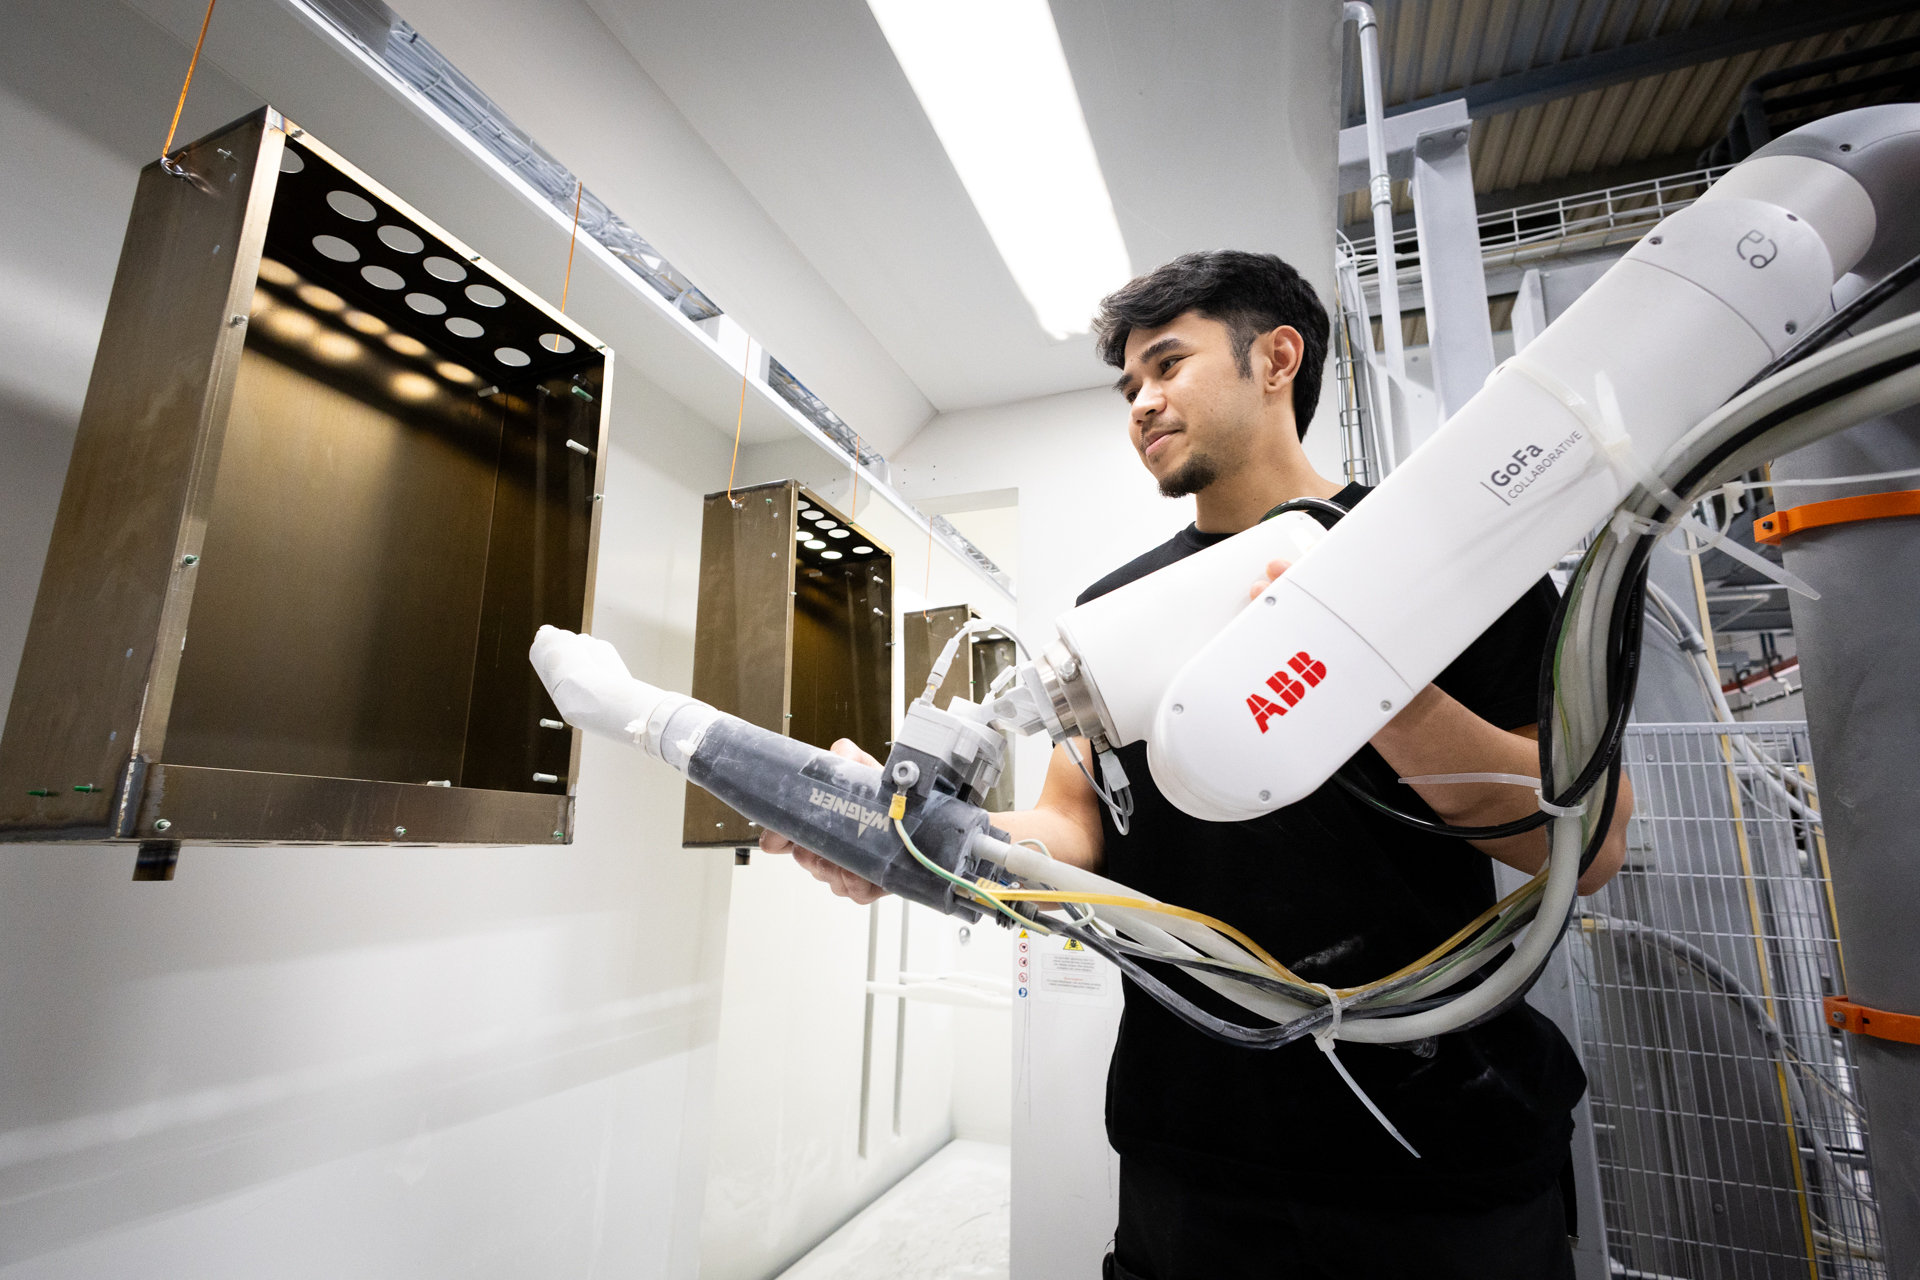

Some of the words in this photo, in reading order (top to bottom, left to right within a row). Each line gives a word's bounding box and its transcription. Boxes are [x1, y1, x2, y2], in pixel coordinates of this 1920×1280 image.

[1490, 444, 1544, 487] GoFa
[1507, 430, 1583, 499] COLLABORATIVE
[1245, 651, 1327, 735] ABB
[808, 787, 891, 838] WAGNER
